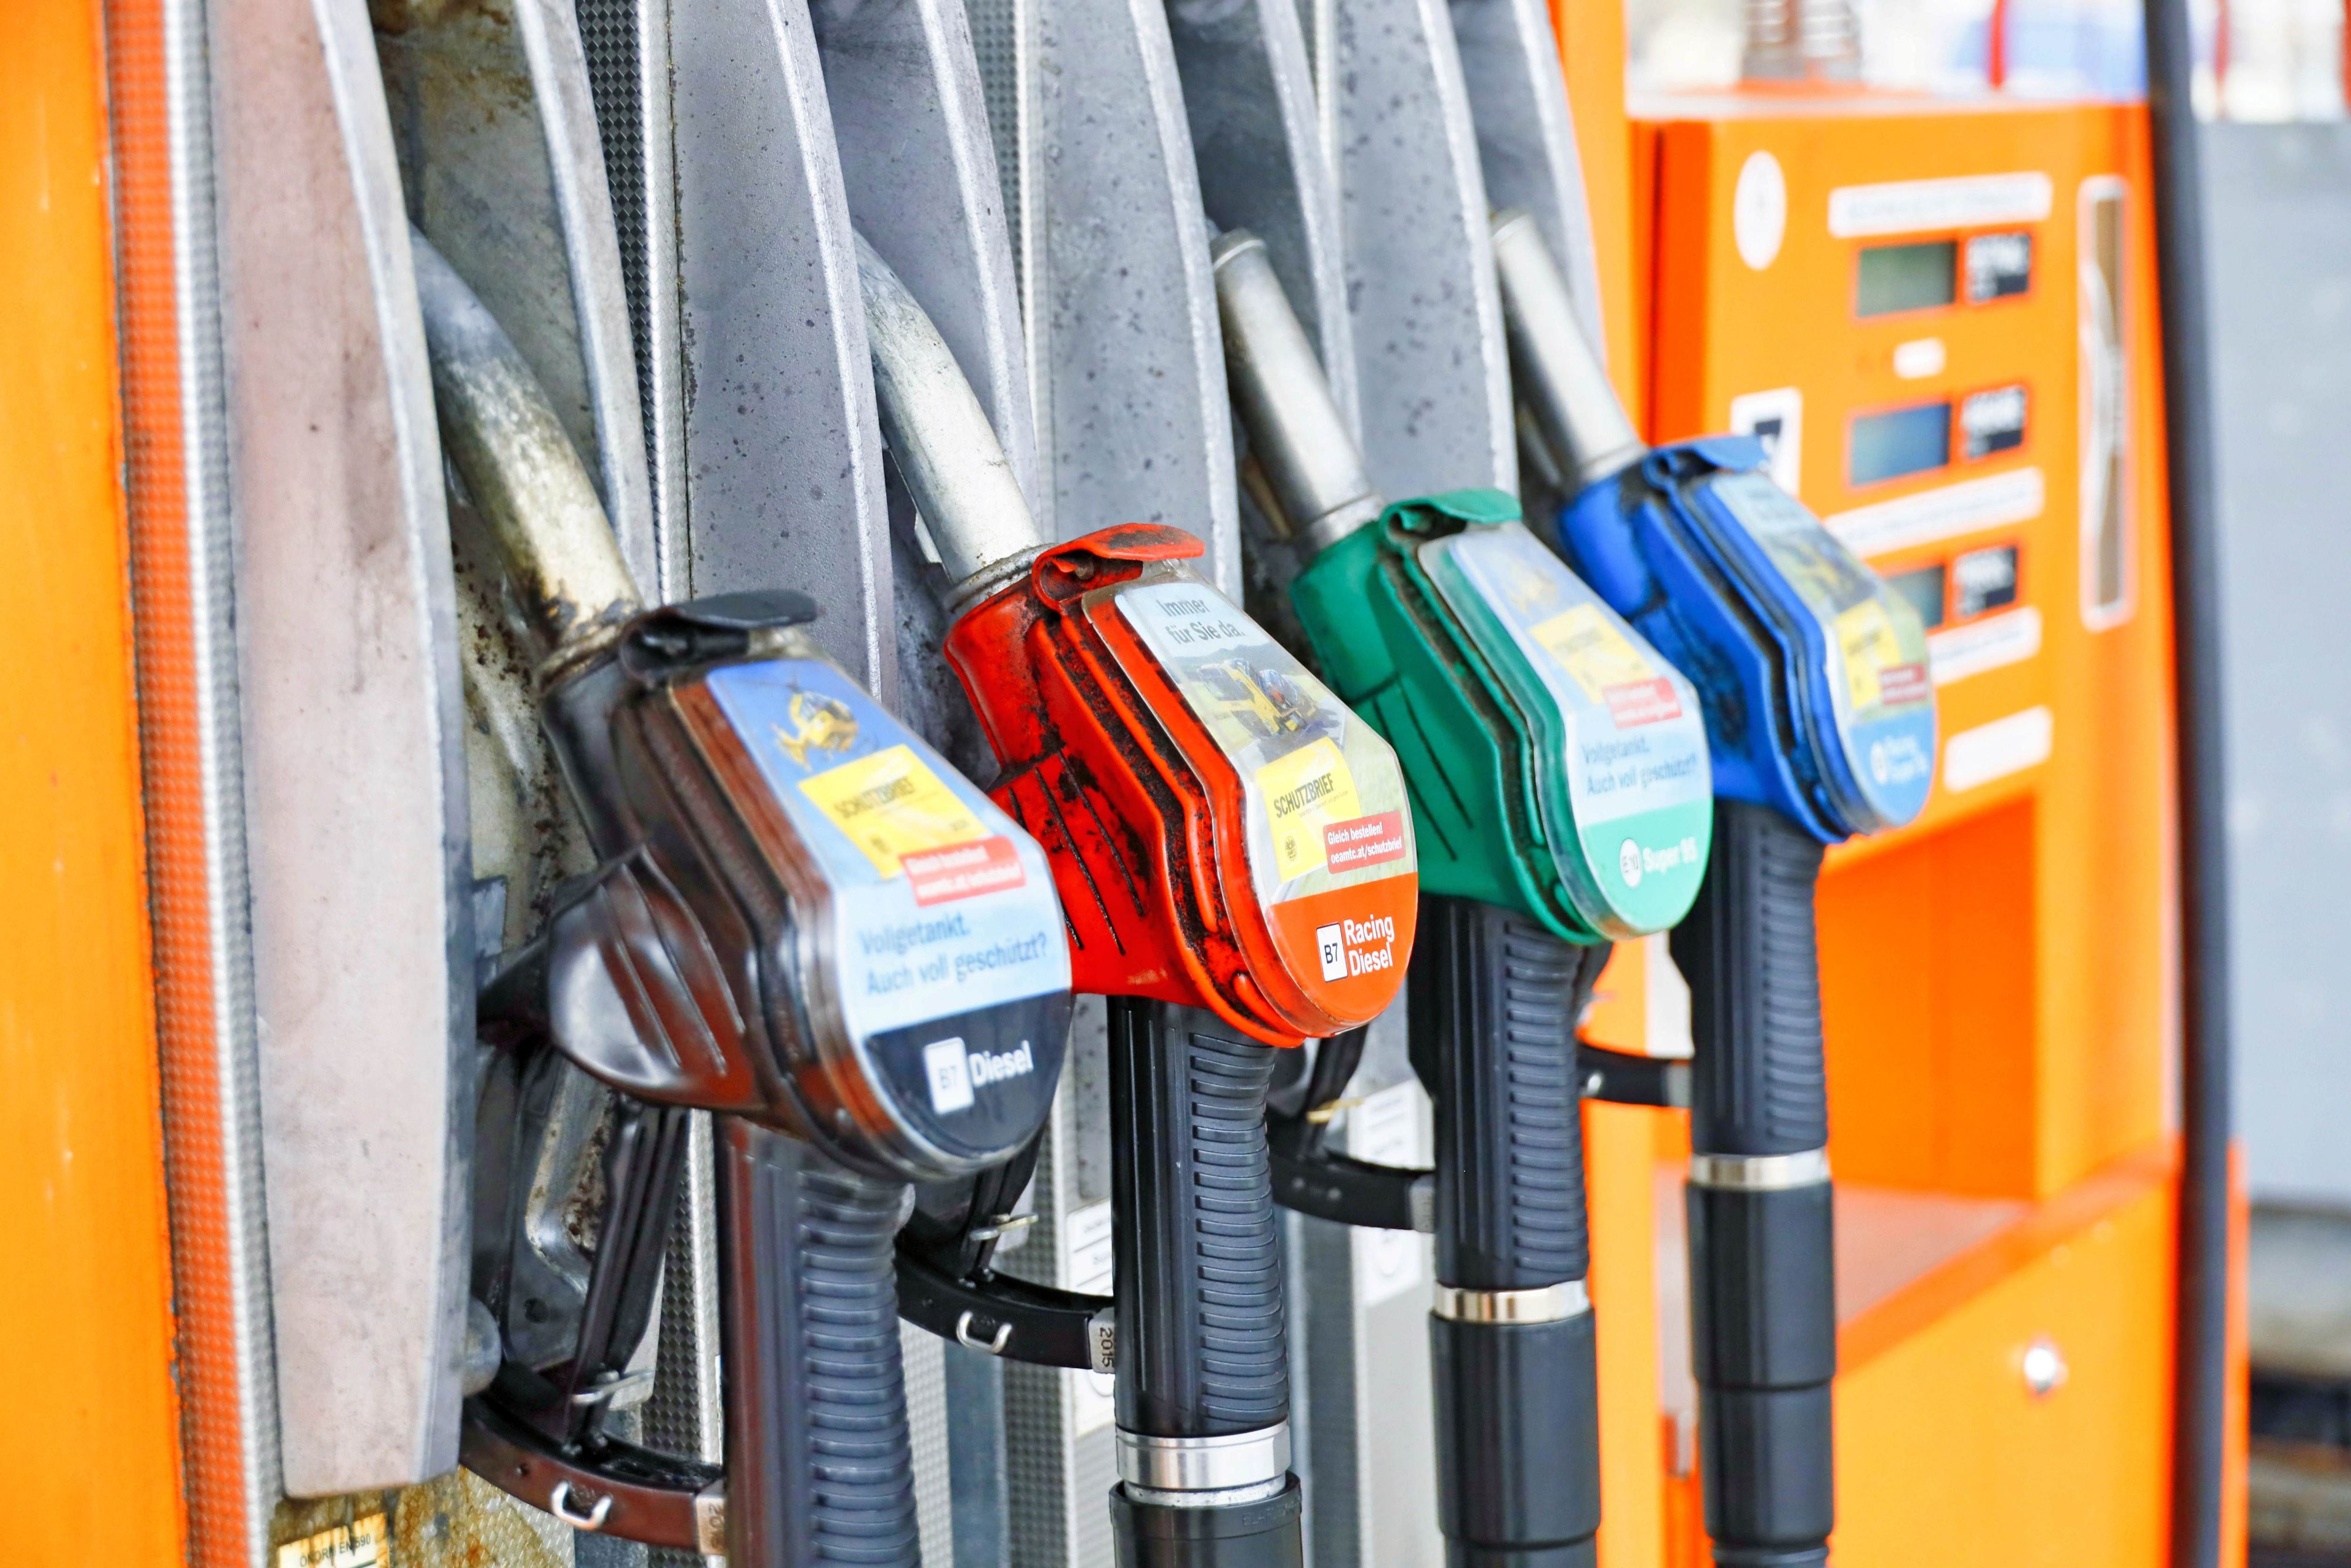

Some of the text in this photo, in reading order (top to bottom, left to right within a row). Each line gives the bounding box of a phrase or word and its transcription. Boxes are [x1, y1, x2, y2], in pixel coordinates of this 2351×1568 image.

[1156, 599, 1210, 617] Immer
[1165, 619, 1245, 645] für Sie da.
[1273, 772, 1334, 819] SCHUTZBRIEF
[1327, 821, 1384, 845] Gleich bestellen!
[1331, 835, 1402, 865] oeamtc.at/schutzbrief
[1642, 846, 1680, 876] Super
[858, 913, 970, 956] Vollgetankt.
[1343, 913, 1395, 946] Racing
[866, 931, 1047, 995] Auch voll geschützt?
[1324, 942, 1338, 964] B7
[1348, 941, 1394, 977] Diesel
[938, 1039, 1034, 1089] B7 Diesel
